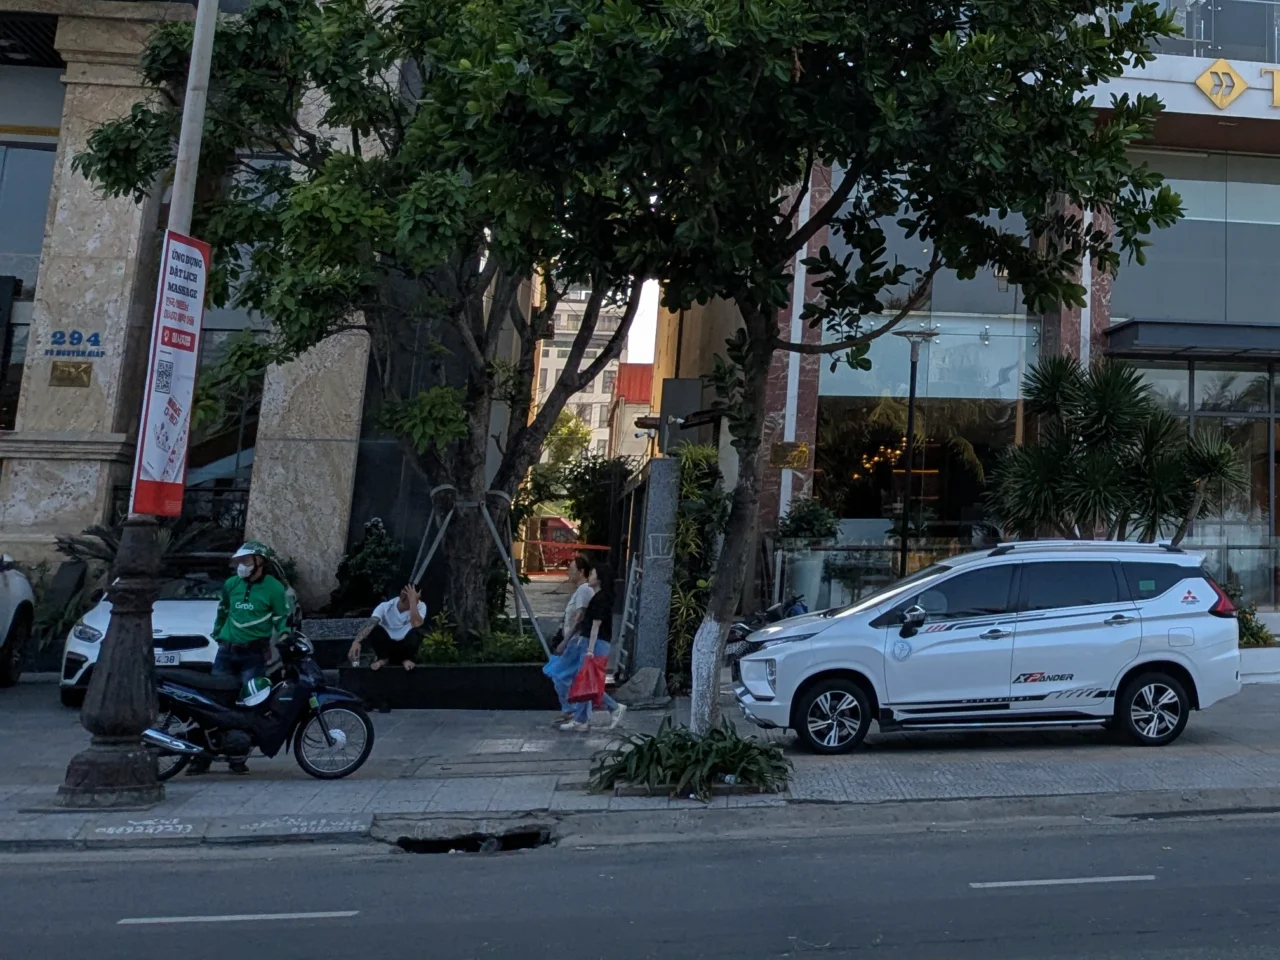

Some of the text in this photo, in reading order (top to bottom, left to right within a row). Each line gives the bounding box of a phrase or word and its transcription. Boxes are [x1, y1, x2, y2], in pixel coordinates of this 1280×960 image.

[167, 282, 198, 300] MASSAGE
[51, 330, 101, 347] 294
[235, 602, 254, 611] Grab
[1012, 672, 1074, 684] XPANDER
